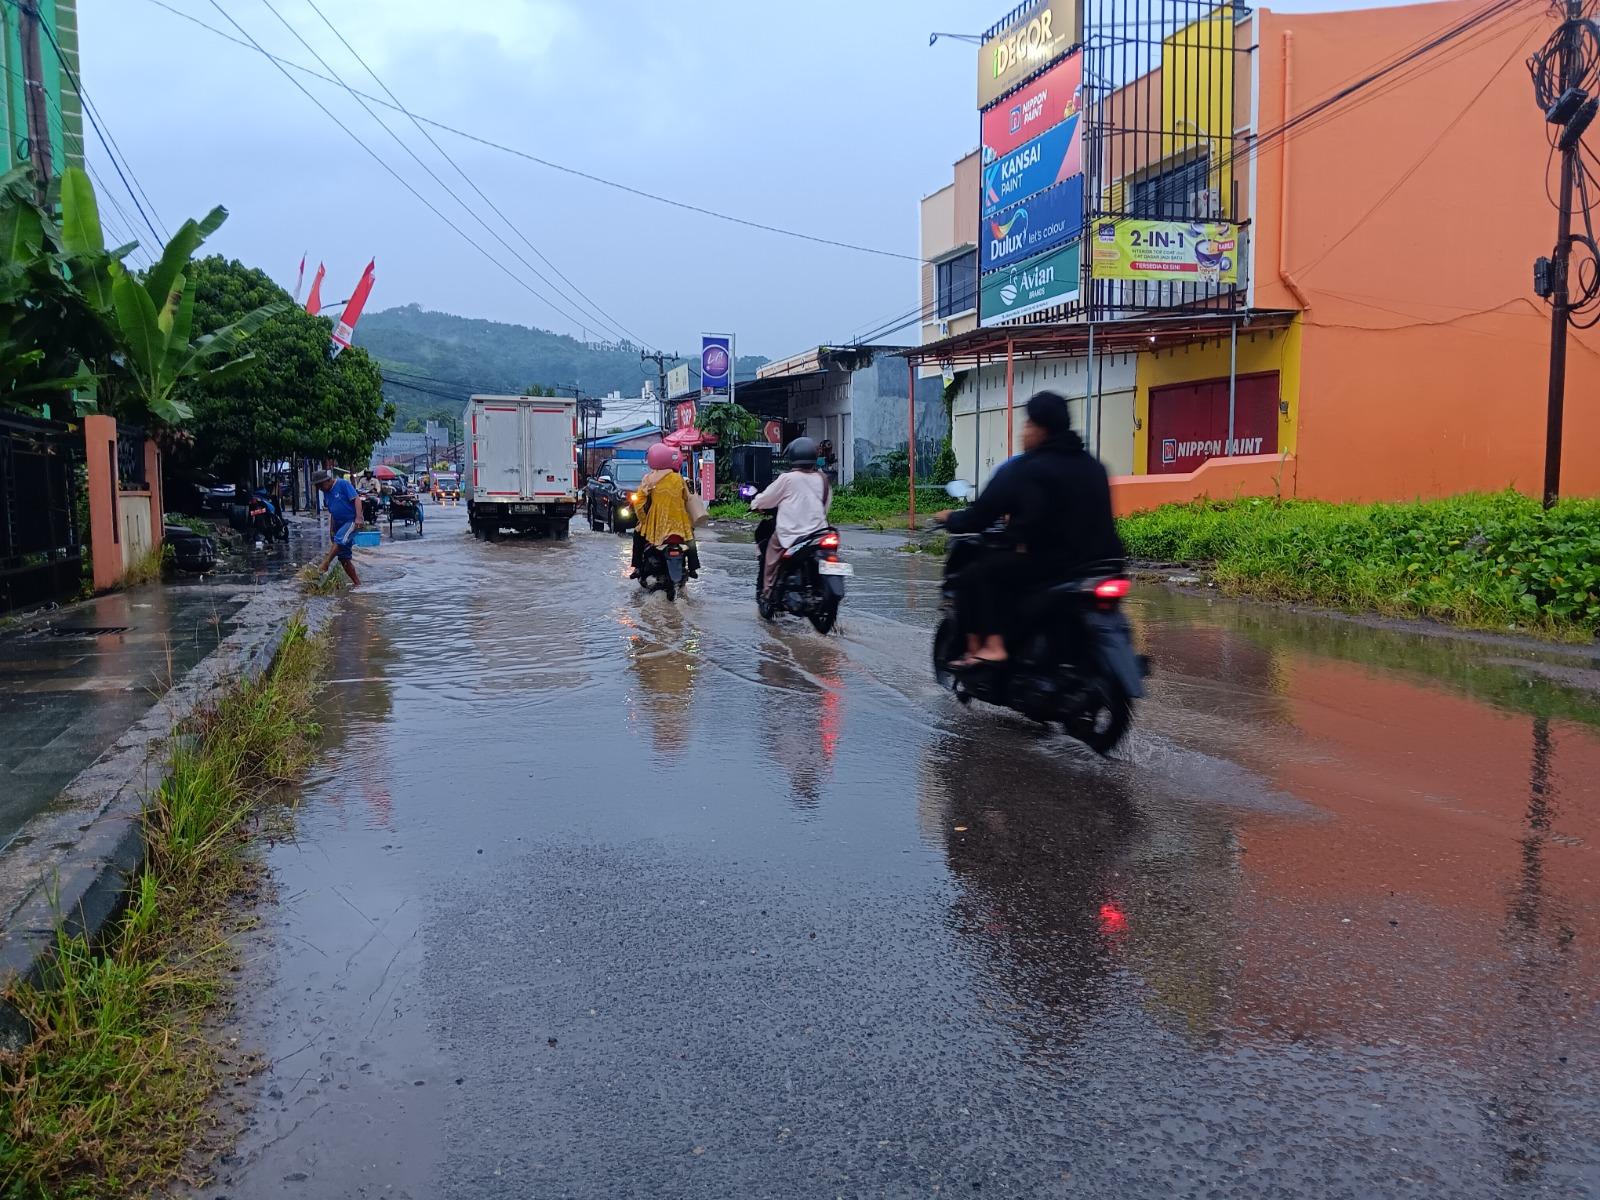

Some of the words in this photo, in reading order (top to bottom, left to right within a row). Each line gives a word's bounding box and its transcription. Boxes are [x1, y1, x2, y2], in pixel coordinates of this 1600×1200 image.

[1022, 89, 1048, 115] NIPPON
[1023, 104, 1043, 125] PAINT
[1001, 142, 1041, 181] KANSAI
[1001, 173, 1023, 197] PAINT
[1028, 229, 1042, 244] let's
[1043, 219, 1066, 238] colour
[1130, 229, 1185, 249] 2-IN-1
[990, 232, 1023, 261] Dulux
[1135, 262, 1162, 270] TERSEDIA
[1019, 265, 1055, 292] Avian
[1177, 439, 1222, 457] NIPPON
